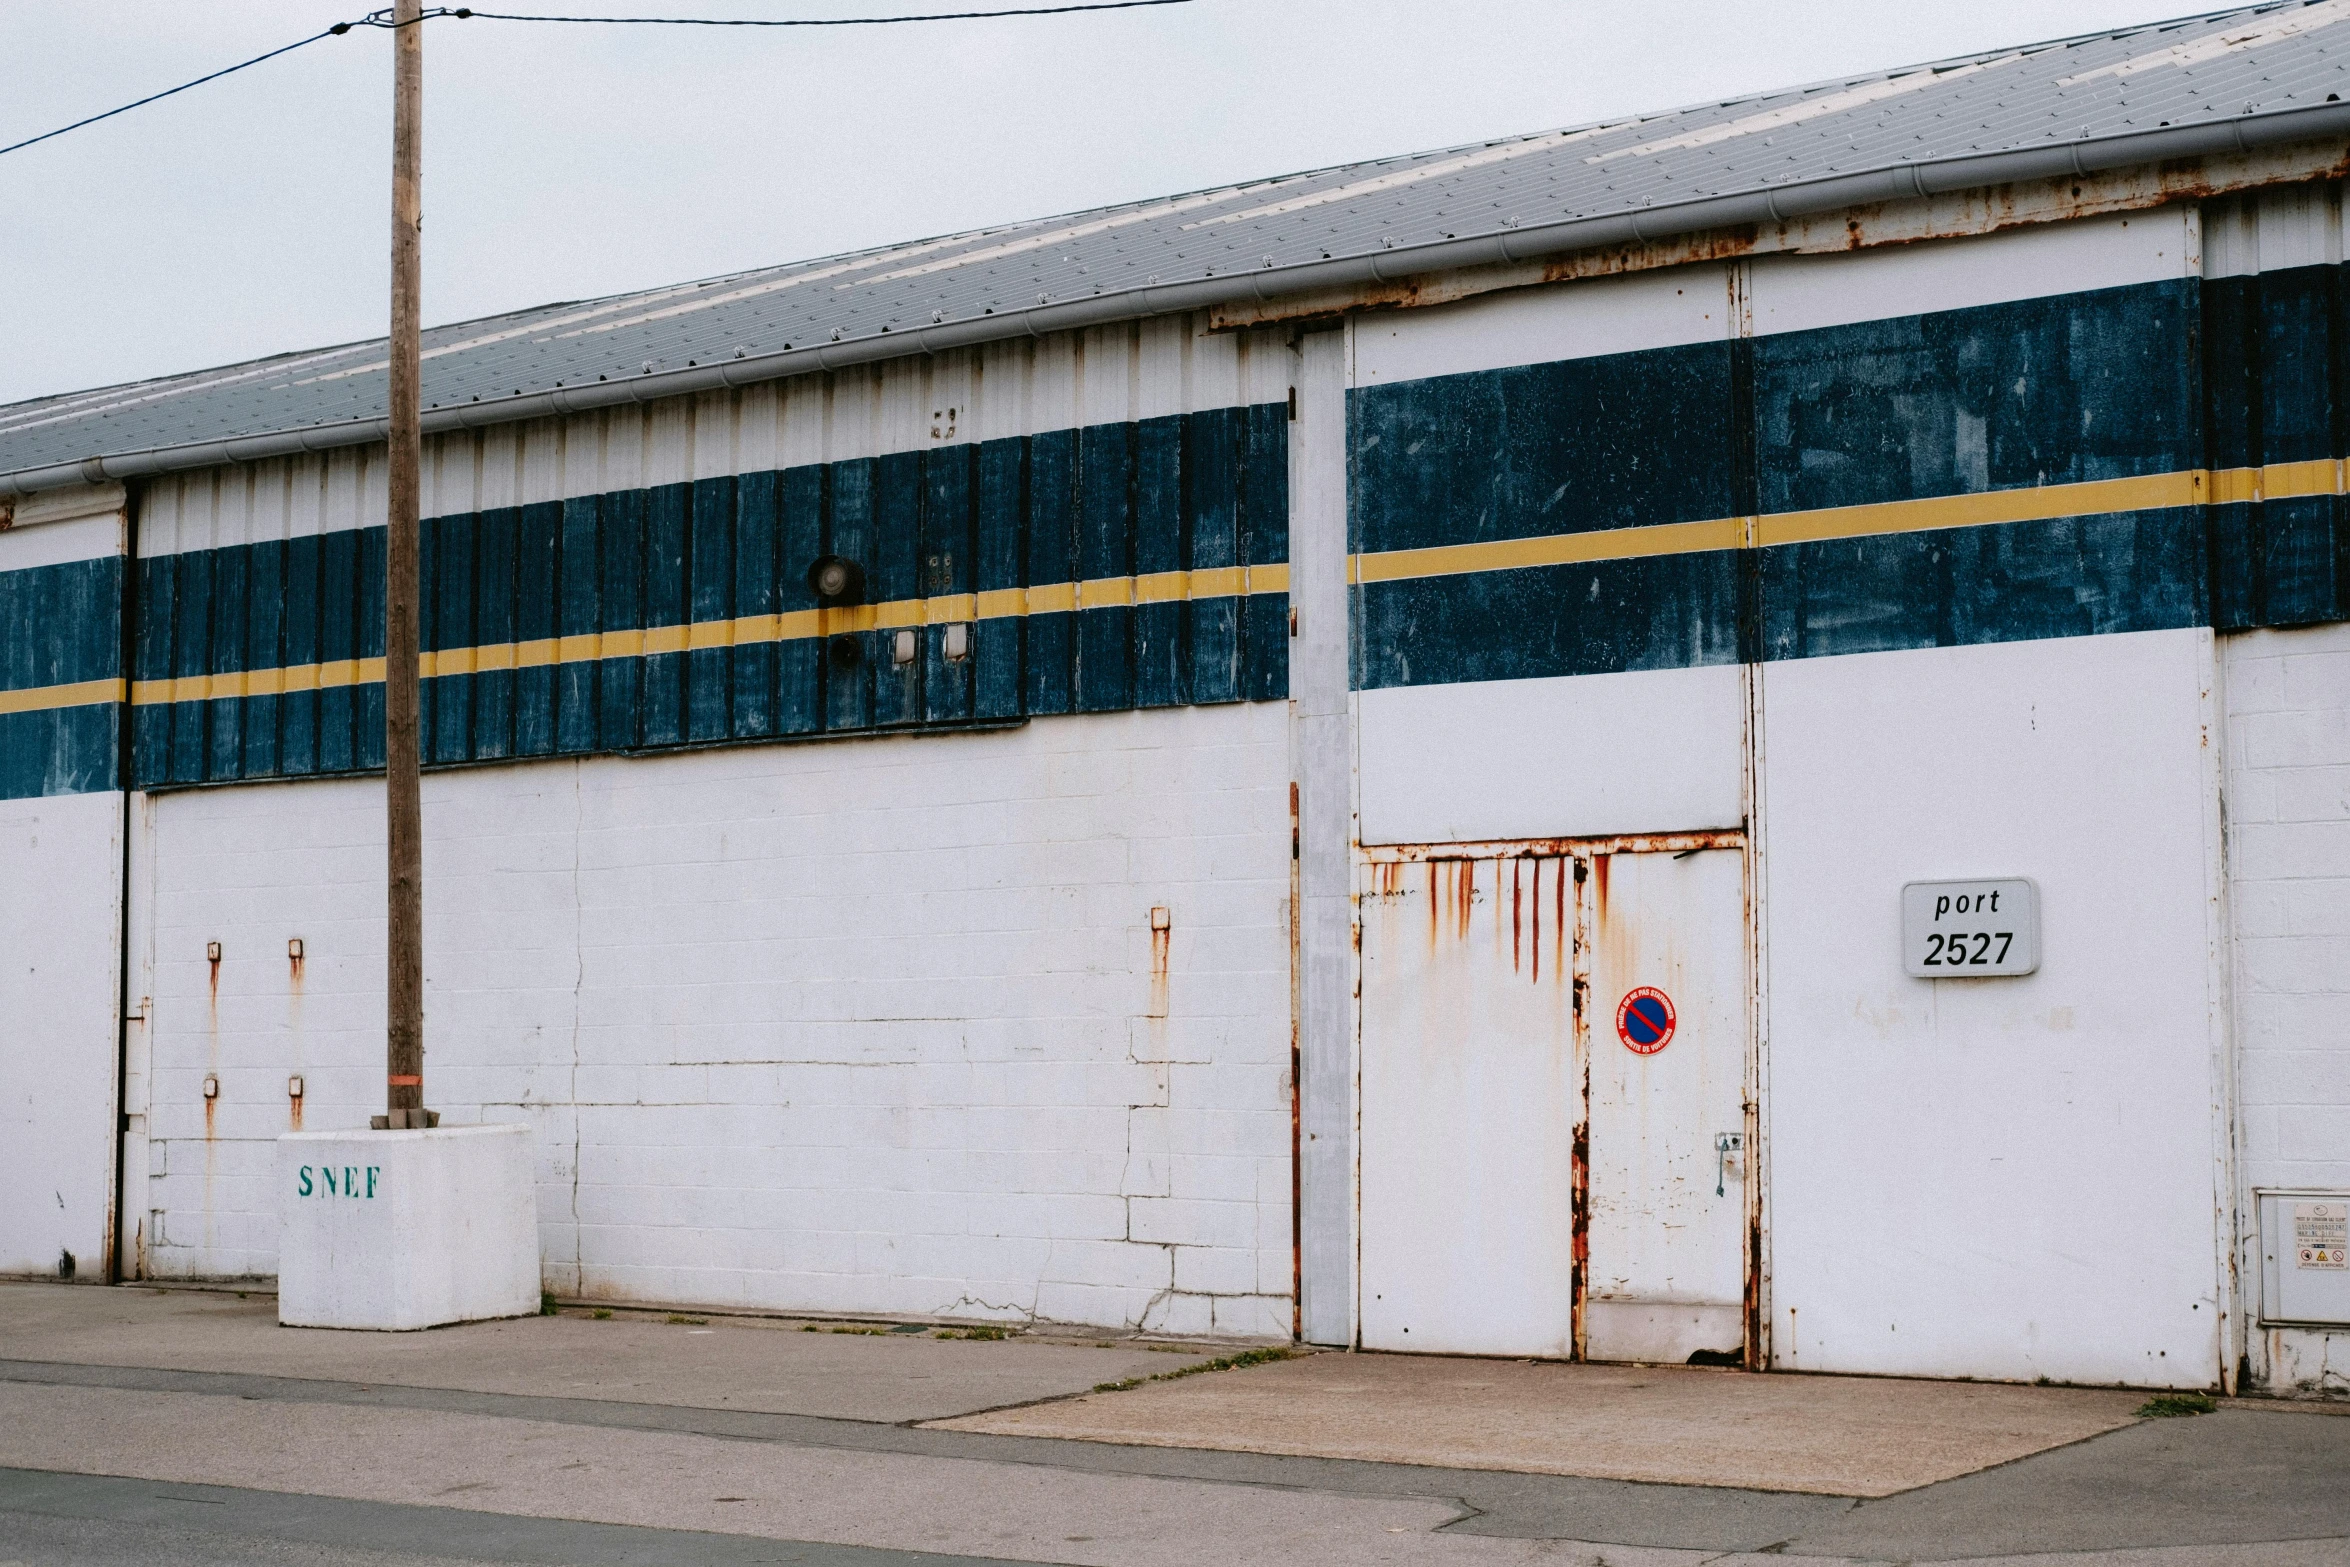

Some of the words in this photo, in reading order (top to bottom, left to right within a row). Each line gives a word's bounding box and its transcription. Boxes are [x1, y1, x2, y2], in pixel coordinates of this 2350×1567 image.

[1935, 890, 1999, 921] port
[1923, 932, 2013, 965] 2527
[1623, 998, 1631, 1007] DE
[1630, 992, 1638, 1001] NE
[1623, 1035, 1642, 1052] SORTIE
[1642, 1045, 1650, 1053] DE
[1650, 1027, 1673, 1052] VOITURES
[299, 1165, 380, 1198] SNEF
